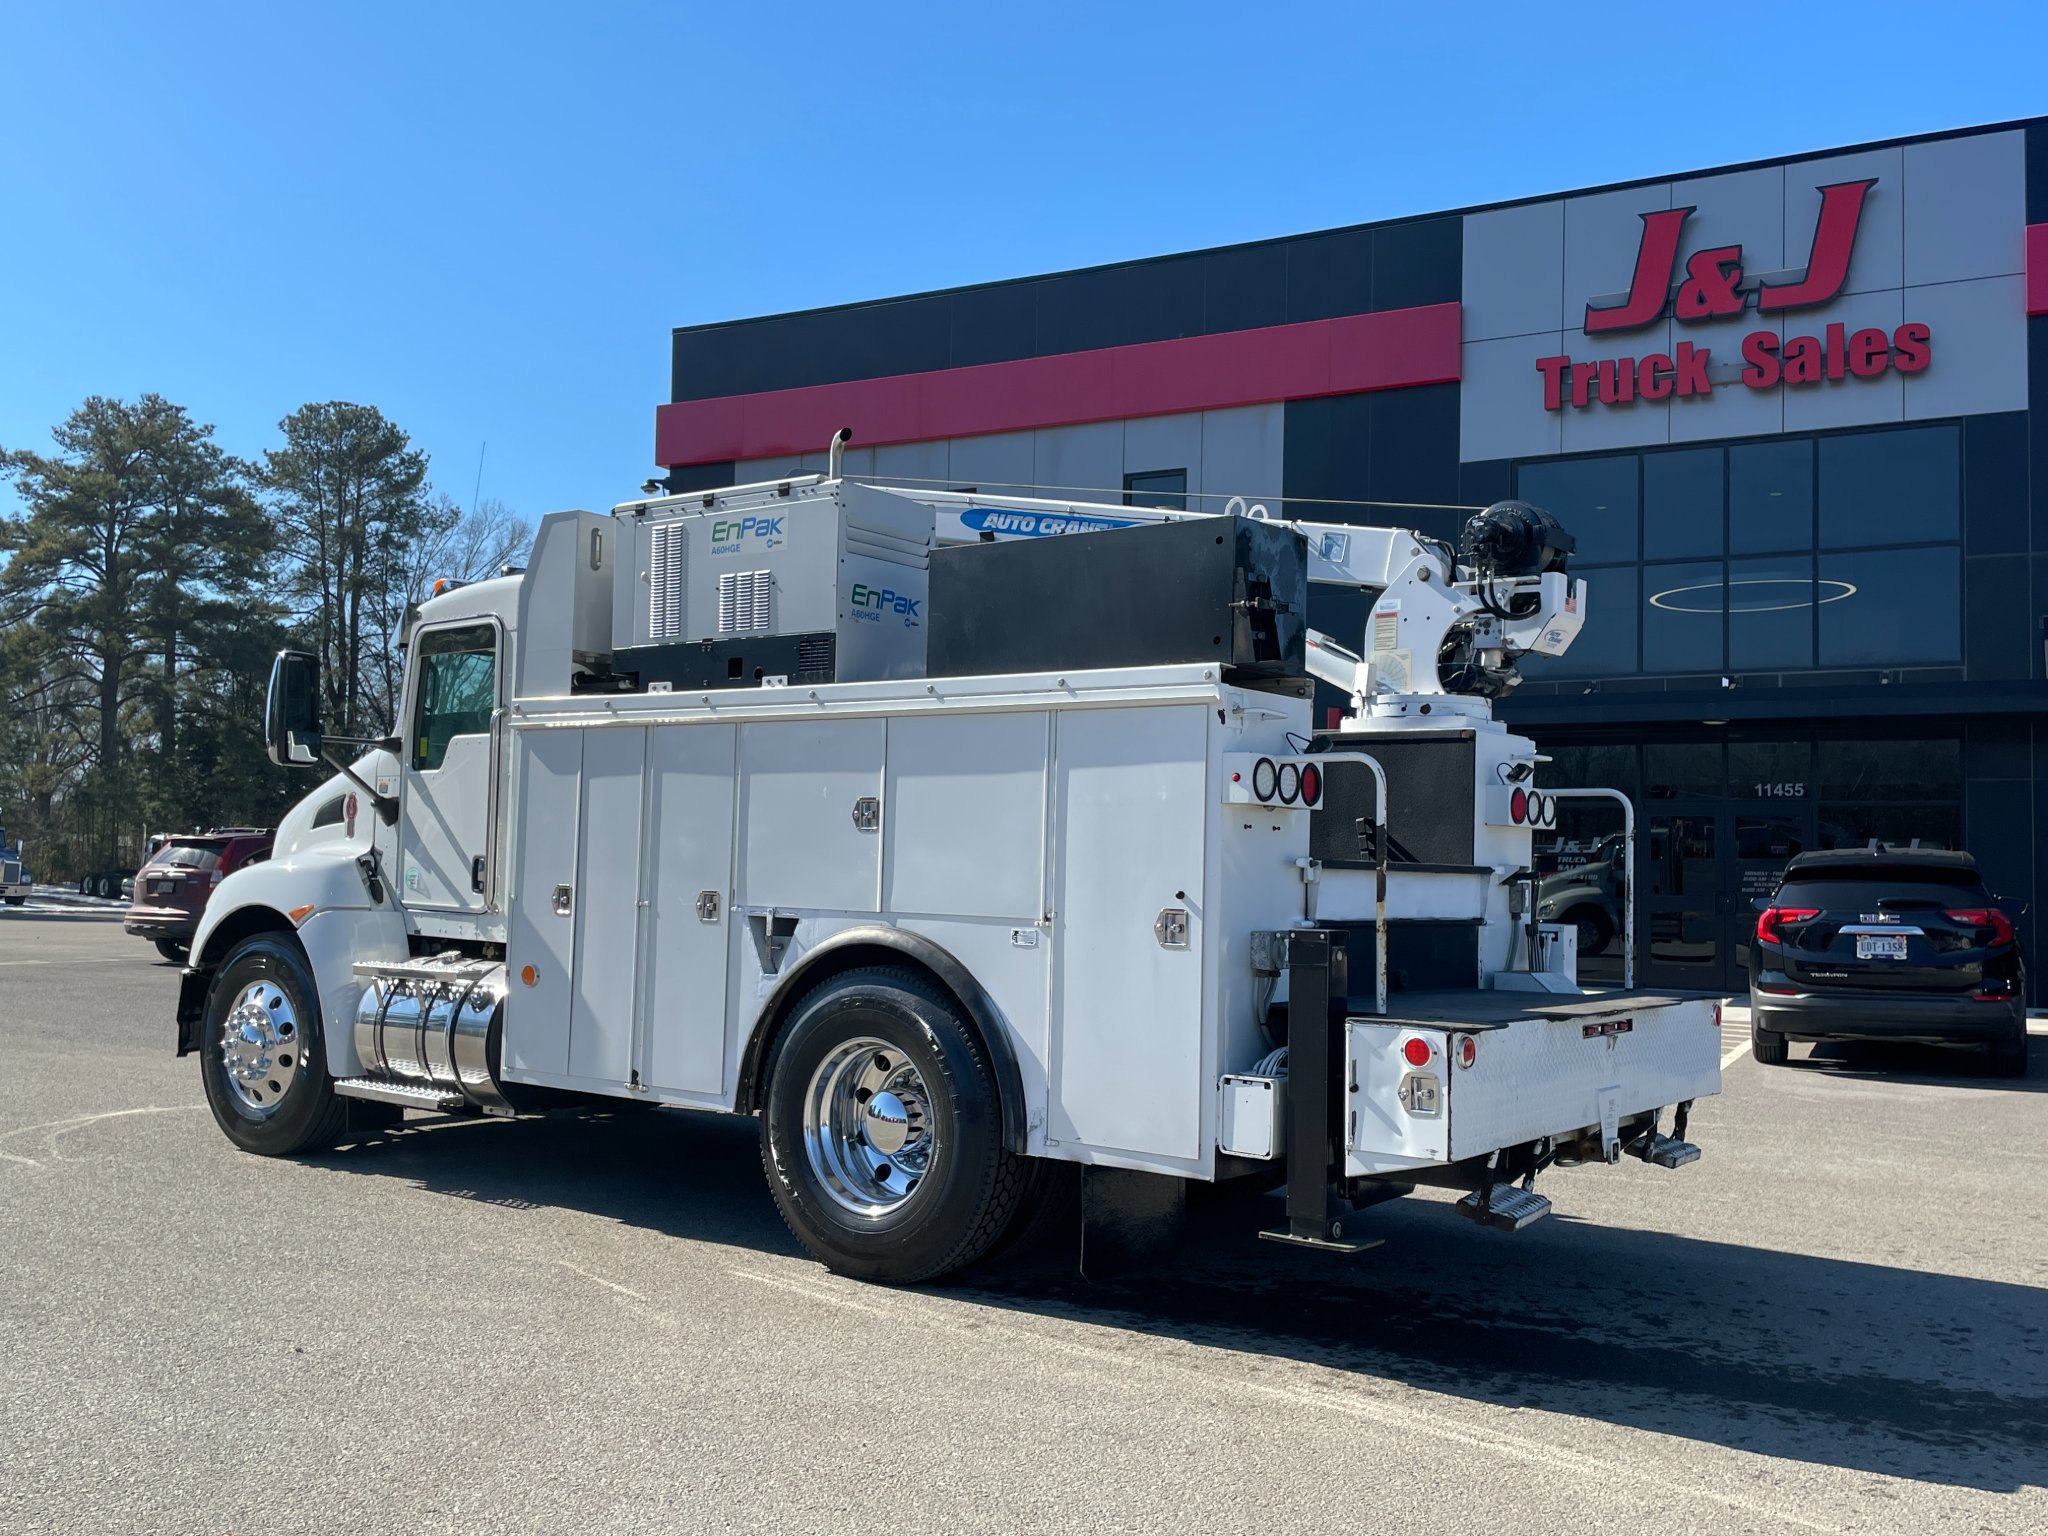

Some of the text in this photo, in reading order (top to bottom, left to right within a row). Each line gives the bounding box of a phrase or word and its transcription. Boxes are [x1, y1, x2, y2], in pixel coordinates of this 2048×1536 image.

[1584, 177, 1880, 336] J&J
[1536, 322, 1931, 411] Truck Sales
[711, 516, 785, 543] EnPak
[982, 513, 1036, 532] AUTO
[711, 543, 741, 555] A60HGE
[851, 583, 922, 617] EnPak
[851, 608, 880, 622] A60HGE
[1755, 783, 1804, 797] 11455
[1547, 837, 1601, 853] J&J
[1557, 856, 1587, 864] TRUCK
